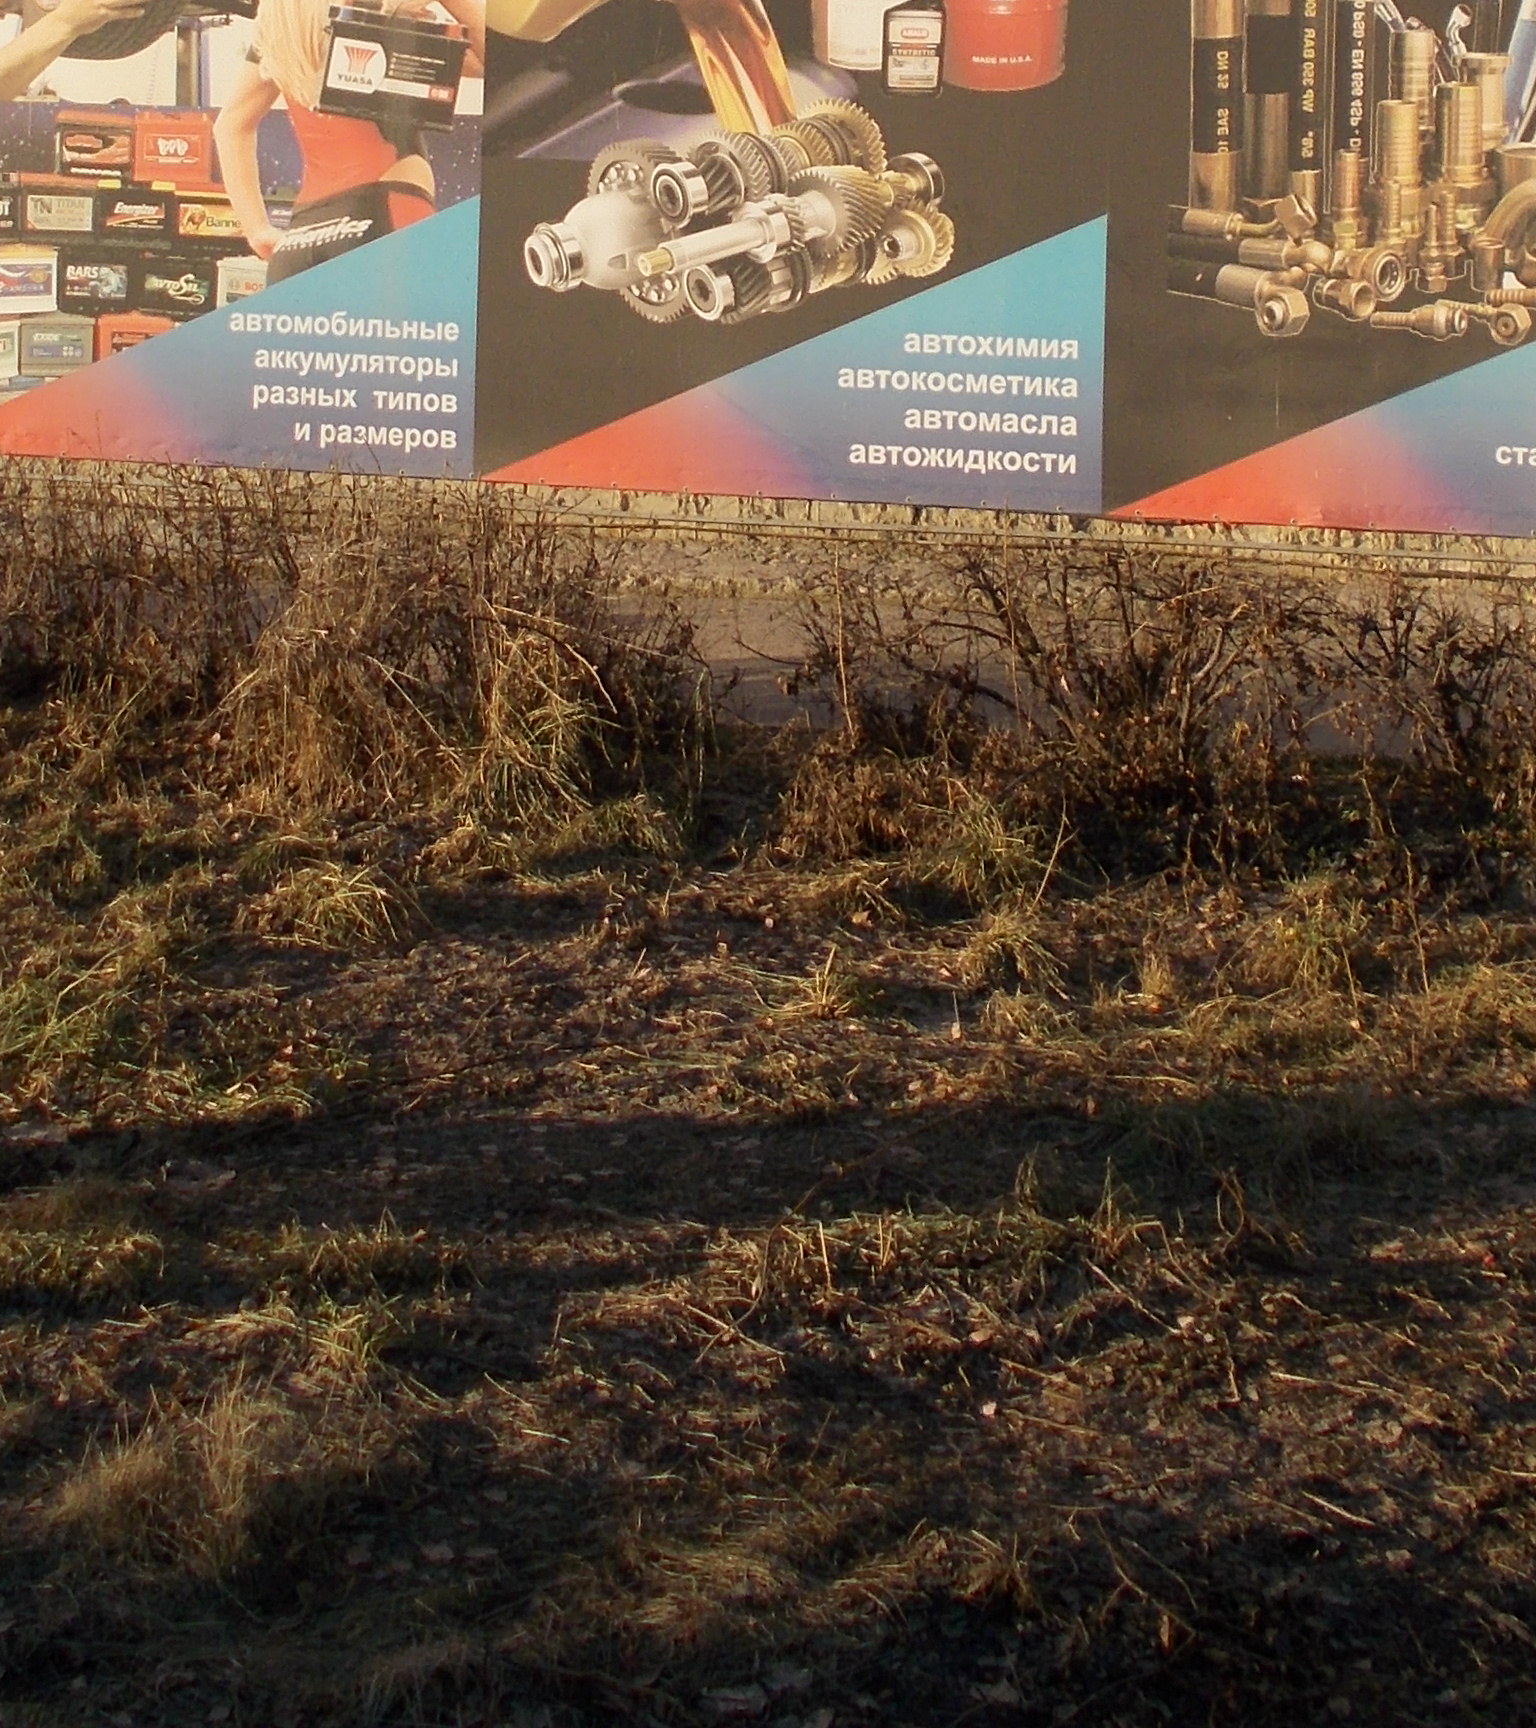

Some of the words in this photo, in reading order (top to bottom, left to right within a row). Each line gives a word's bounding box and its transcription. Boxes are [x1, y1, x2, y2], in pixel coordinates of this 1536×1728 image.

[972, 55, 997, 64] MADE
[999, 55, 1008, 64] IN
[337, 73, 373, 85] YUASA
[230, 309, 460, 342] автомобильные
[255, 345, 459, 378] аккумуляторы
[904, 332, 1079, 360] автохимия
[253, 380, 357, 410] разных
[373, 388, 458, 413] типов
[838, 367, 1078, 399] автокосметика
[295, 421, 311, 443] и
[319, 420, 457, 450] размеров
[904, 407, 1077, 437] автомасла
[849, 442, 1076, 475] автожидкости
